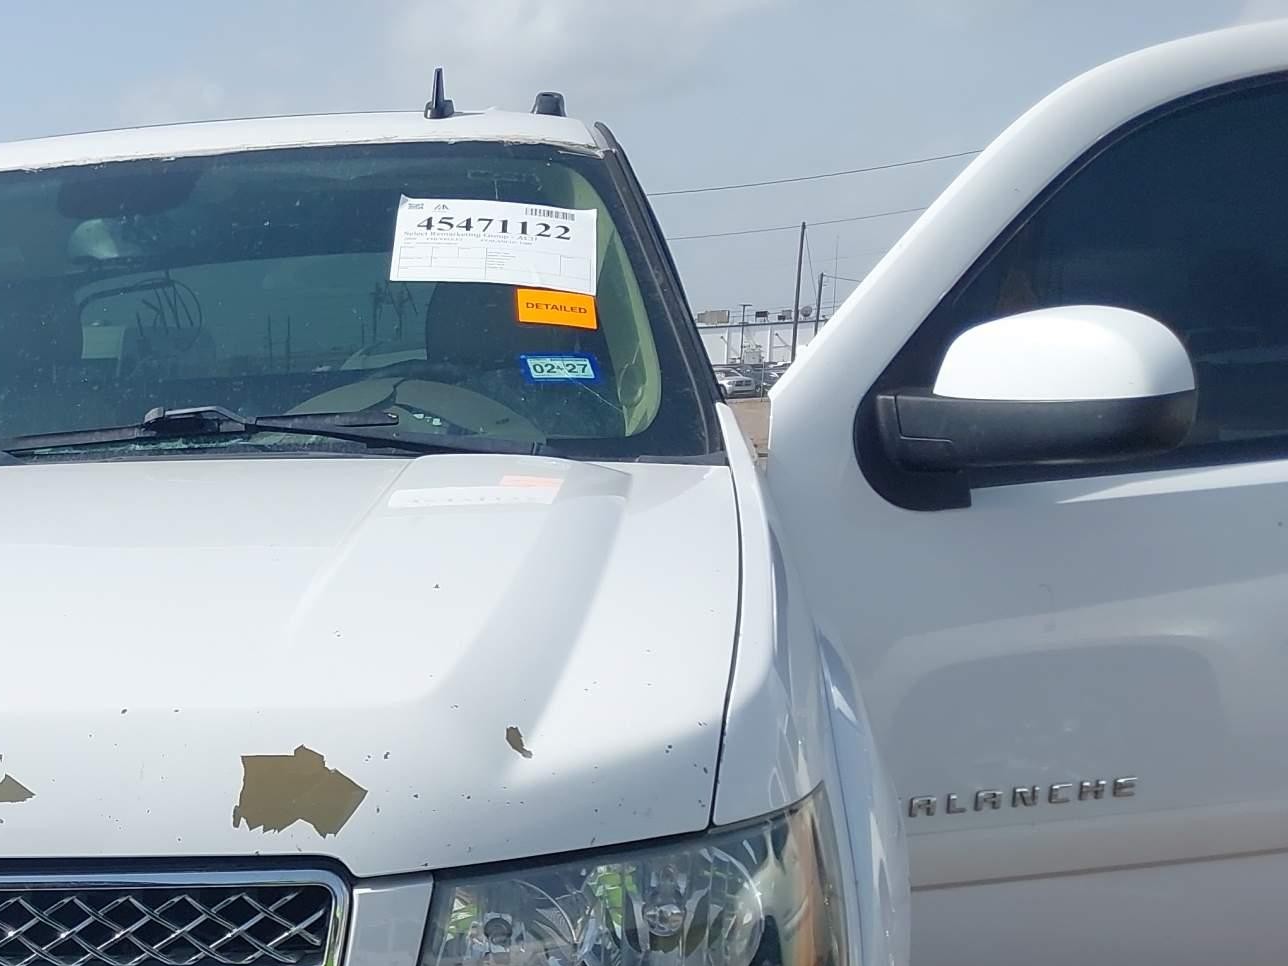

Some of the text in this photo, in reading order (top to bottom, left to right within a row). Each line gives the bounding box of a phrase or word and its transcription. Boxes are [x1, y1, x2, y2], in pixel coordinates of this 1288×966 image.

[416, 216, 572, 241] 45471122
[526, 302, 588, 314] DETAILED
[907, 777, 1139, 818] ALANCHE
